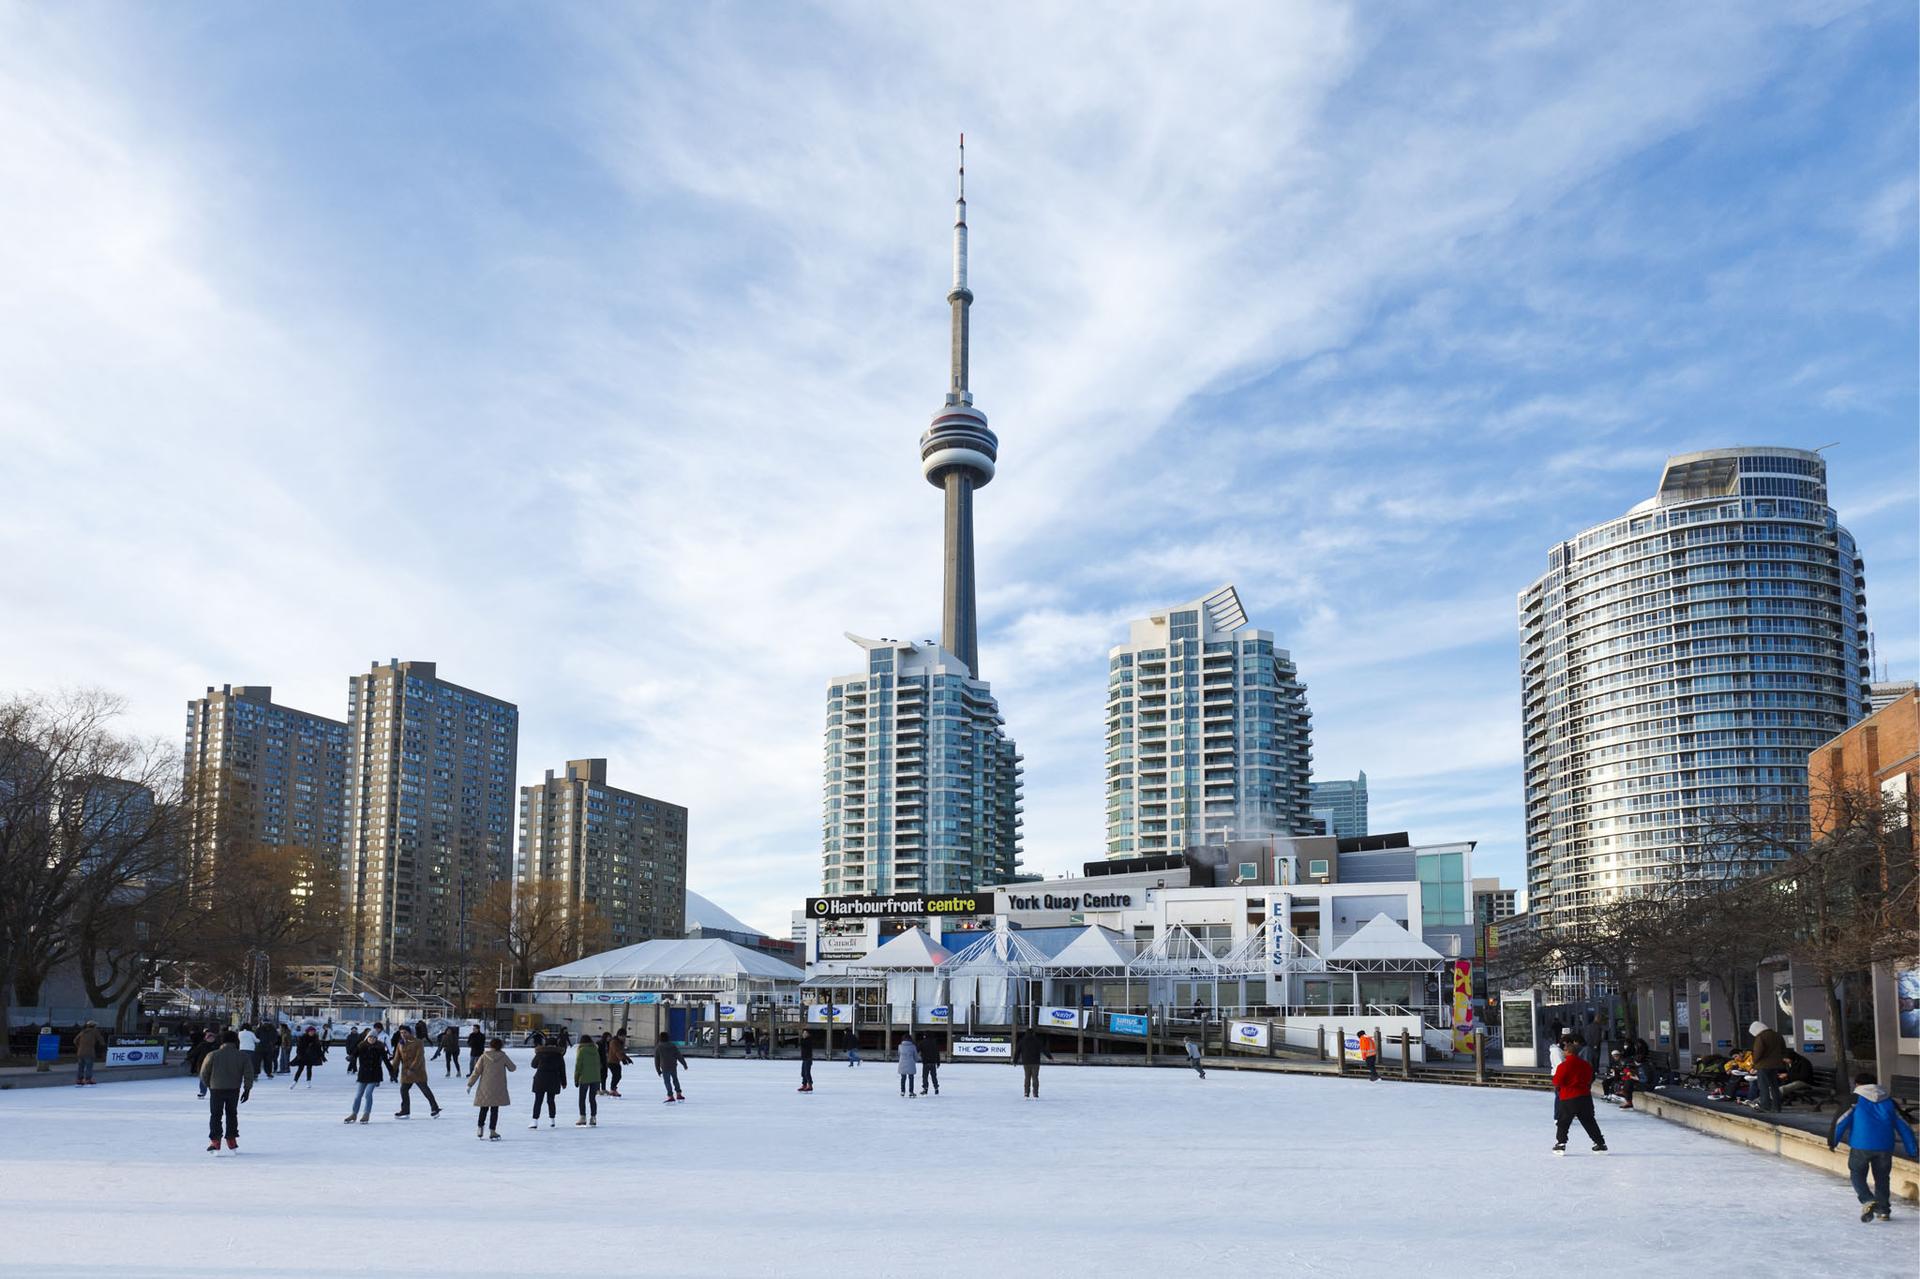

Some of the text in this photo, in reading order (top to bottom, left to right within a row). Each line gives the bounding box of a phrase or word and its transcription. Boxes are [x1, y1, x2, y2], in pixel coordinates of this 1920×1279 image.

[830, 897, 976, 914] Harbourfront centre
[1008, 892, 1131, 911] York Quay Centre
[112, 1052, 126, 1061] THE
[144, 1051, 160, 1060] RINK
